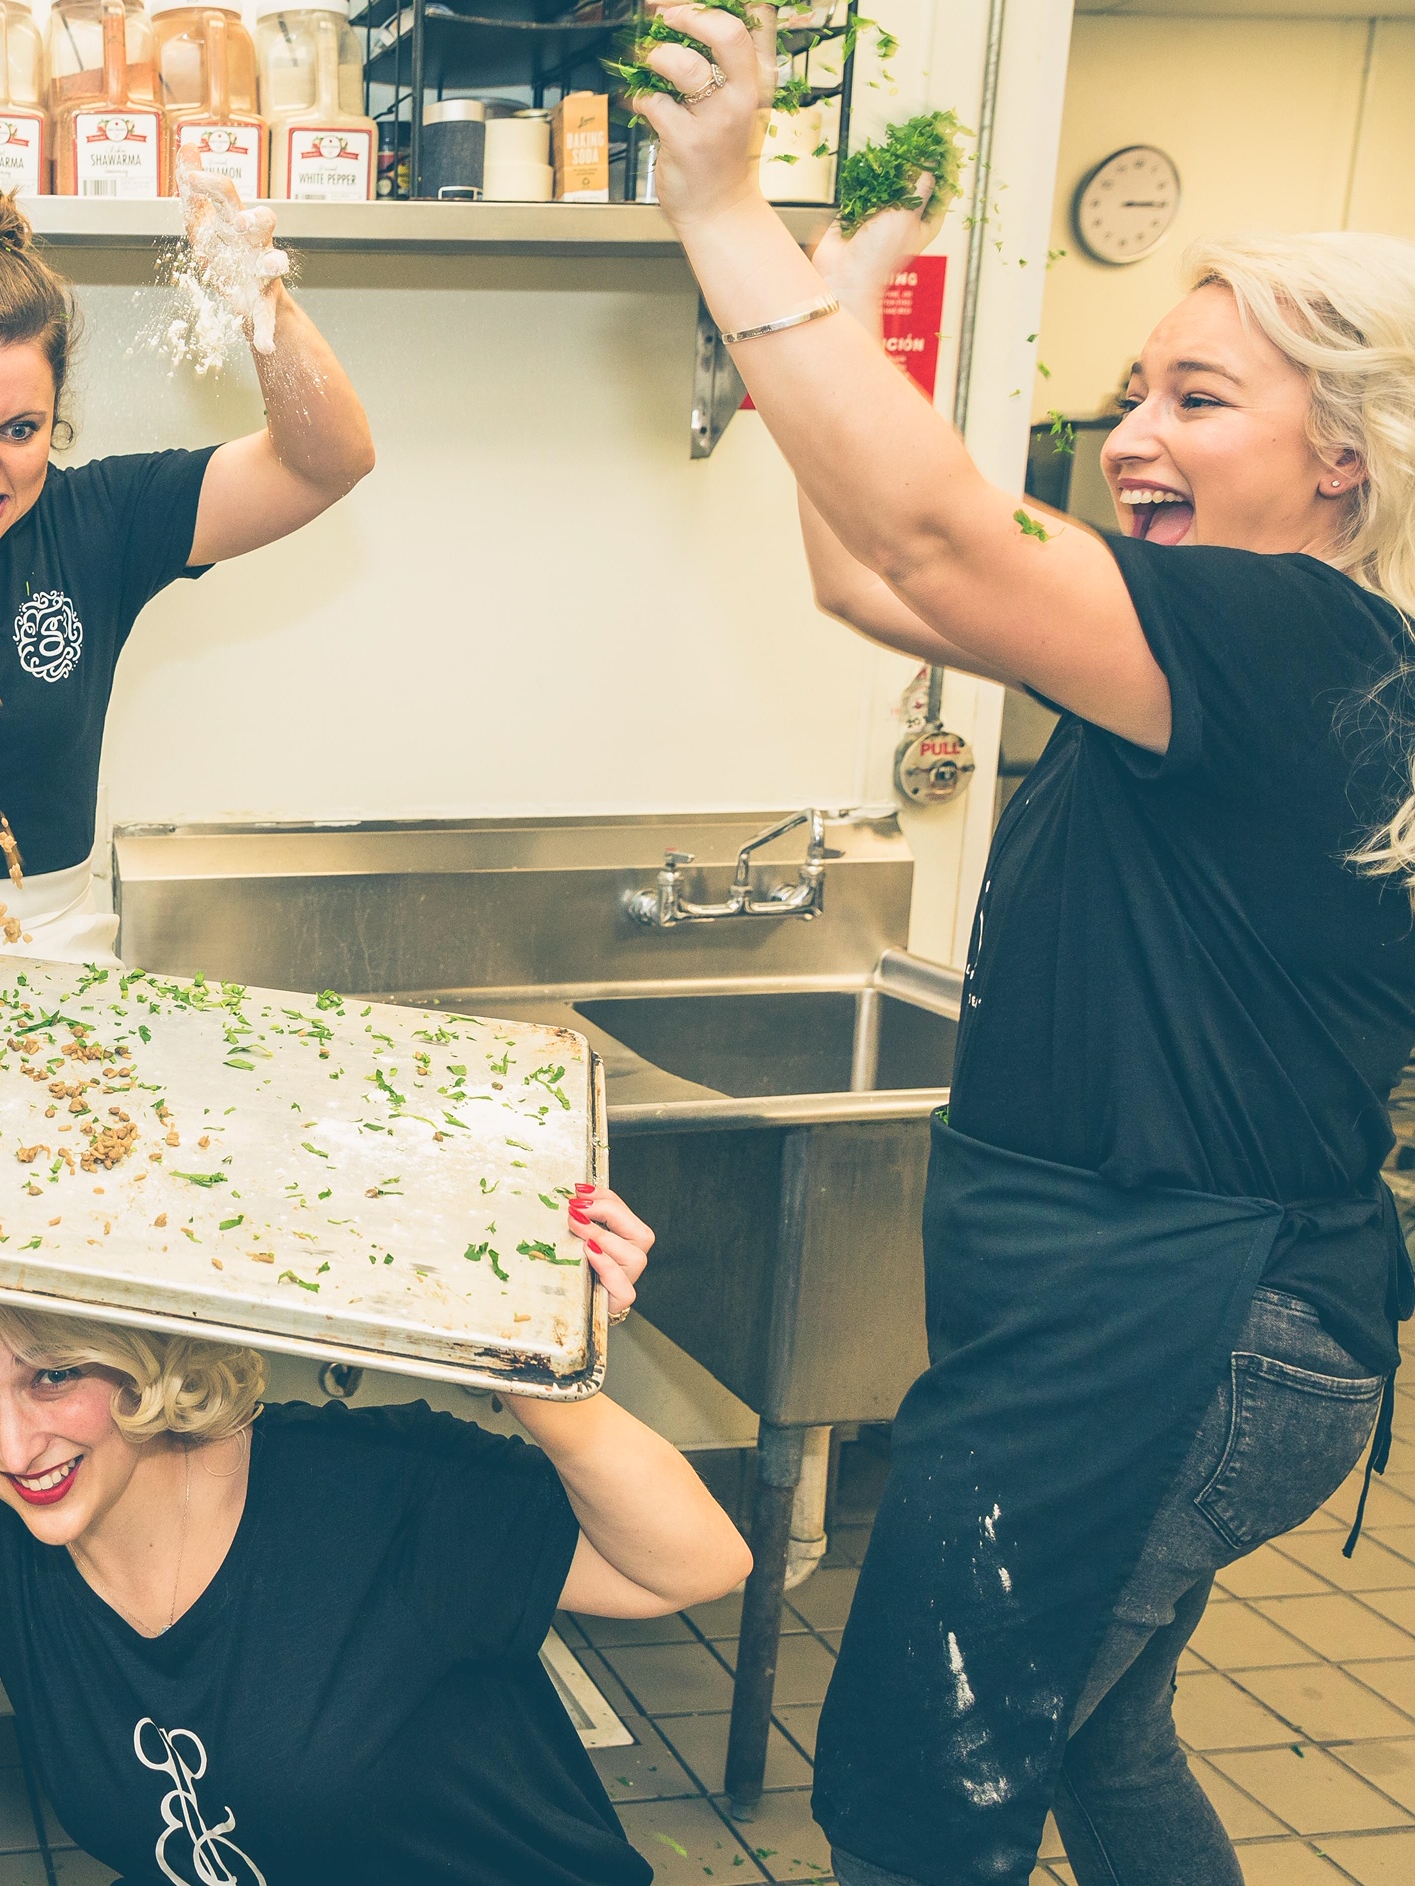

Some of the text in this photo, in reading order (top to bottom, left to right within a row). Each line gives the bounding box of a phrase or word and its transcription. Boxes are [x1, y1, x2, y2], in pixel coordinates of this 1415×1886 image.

[566, 131, 605, 150] BAKING
[90, 153, 142, 167] SHAWARMA
[572, 148, 600, 166] SODA
[299, 173, 357, 186] WHITE PEPPER
[920, 741, 961, 757] PULL
